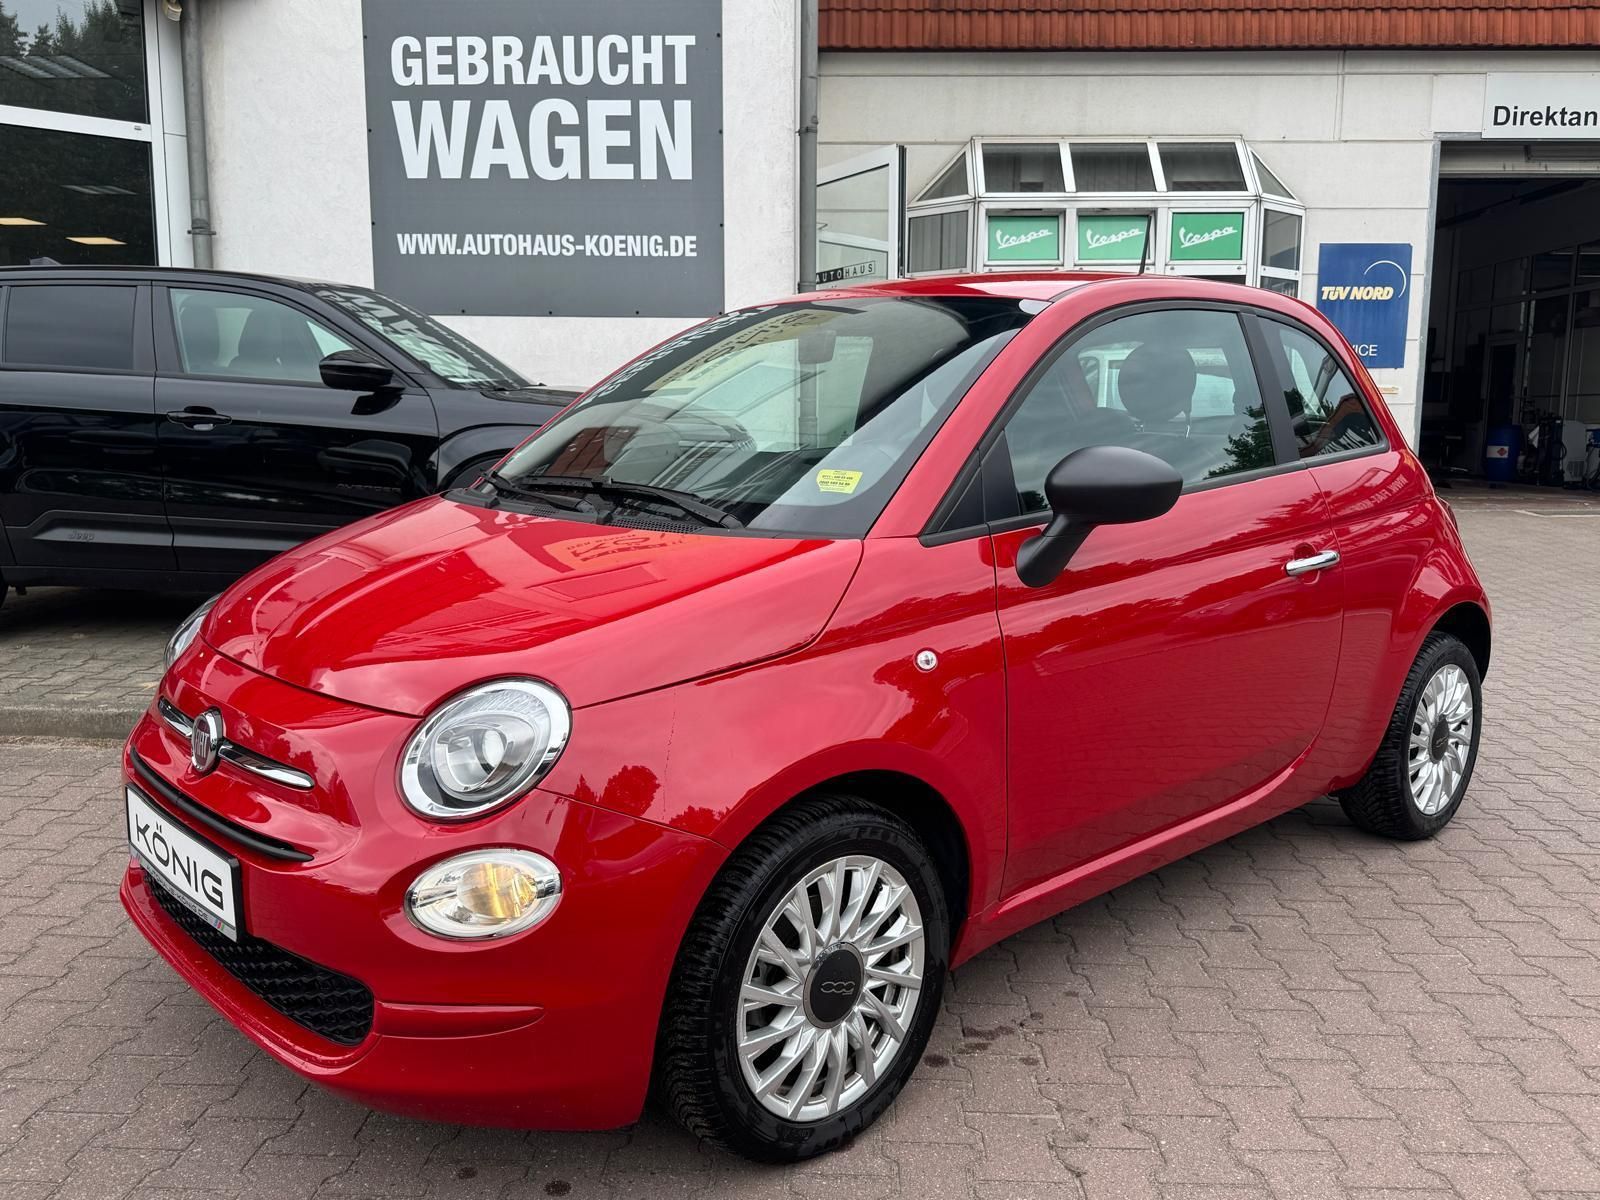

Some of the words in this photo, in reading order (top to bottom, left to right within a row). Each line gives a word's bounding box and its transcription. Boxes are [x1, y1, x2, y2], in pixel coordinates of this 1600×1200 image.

[391, 34, 696, 87] GEBRAUCHT
[1493, 105, 1598, 127] Direktan
[391, 98, 693, 180] WAGEN
[397, 233, 697, 257] WWW.AUTOHAUS-KOENIG.DE
[996, 229, 1053, 249] Vespa
[1087, 229, 1144, 249] Vespa
[1179, 226, 1238, 248] Vespa
[816, 263, 873, 283] AUTOHAUS
[1321, 286, 1351, 301] TÜV
[1349, 286, 1394, 301] NORD
[136, 814, 224, 911] KÖNIG
